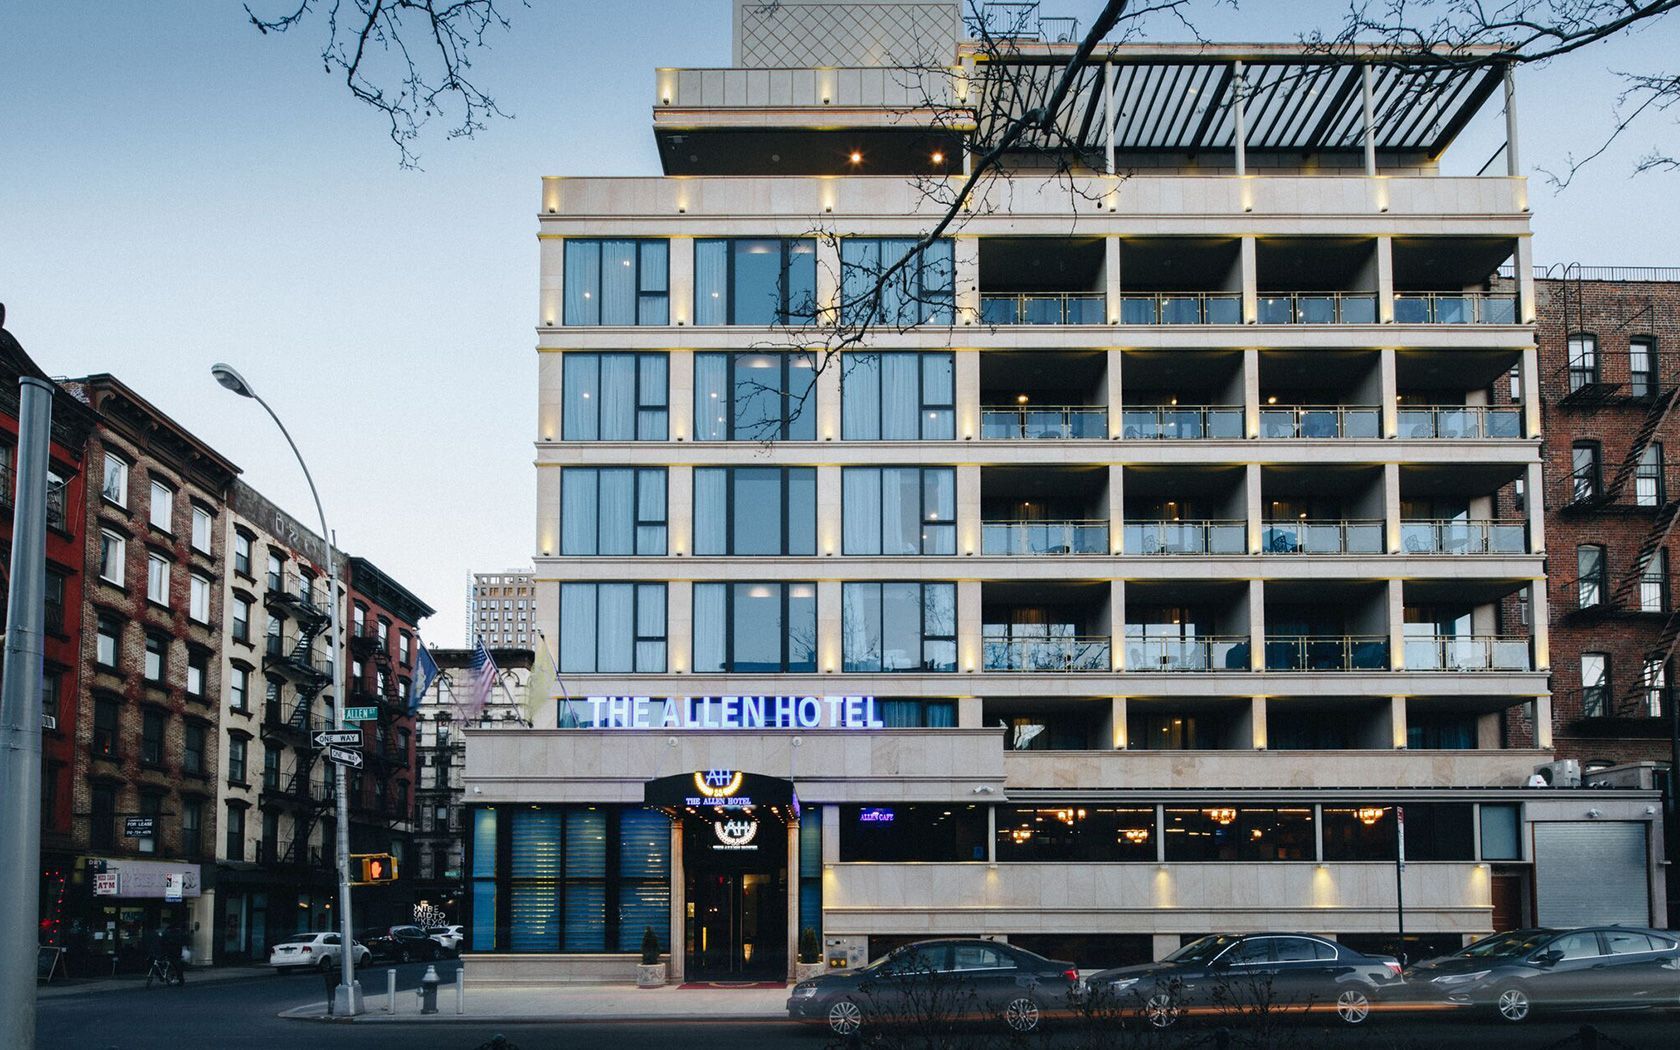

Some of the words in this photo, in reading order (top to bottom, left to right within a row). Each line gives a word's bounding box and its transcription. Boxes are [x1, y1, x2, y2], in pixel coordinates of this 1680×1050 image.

[346, 709, 368, 719] ALLEN
[588, 697, 650, 728] THE
[662, 697, 765, 728] ALLEN
[775, 697, 884, 728] HOTEL
[320, 735, 333, 743] ONE
[333, 750, 342, 758] ONE
[348, 754, 358, 762] WAY
[705, 768, 733, 786] AH
[685, 797, 701, 806] THE
[703, 797, 726, 806] ALLEN
[727, 797, 752, 806] HOTEL
[860, 812, 879, 821] ALLEN
[879, 813, 894, 821] CAFE
[724, 820, 750, 836] AH
[97, 881, 116, 889] ATM
